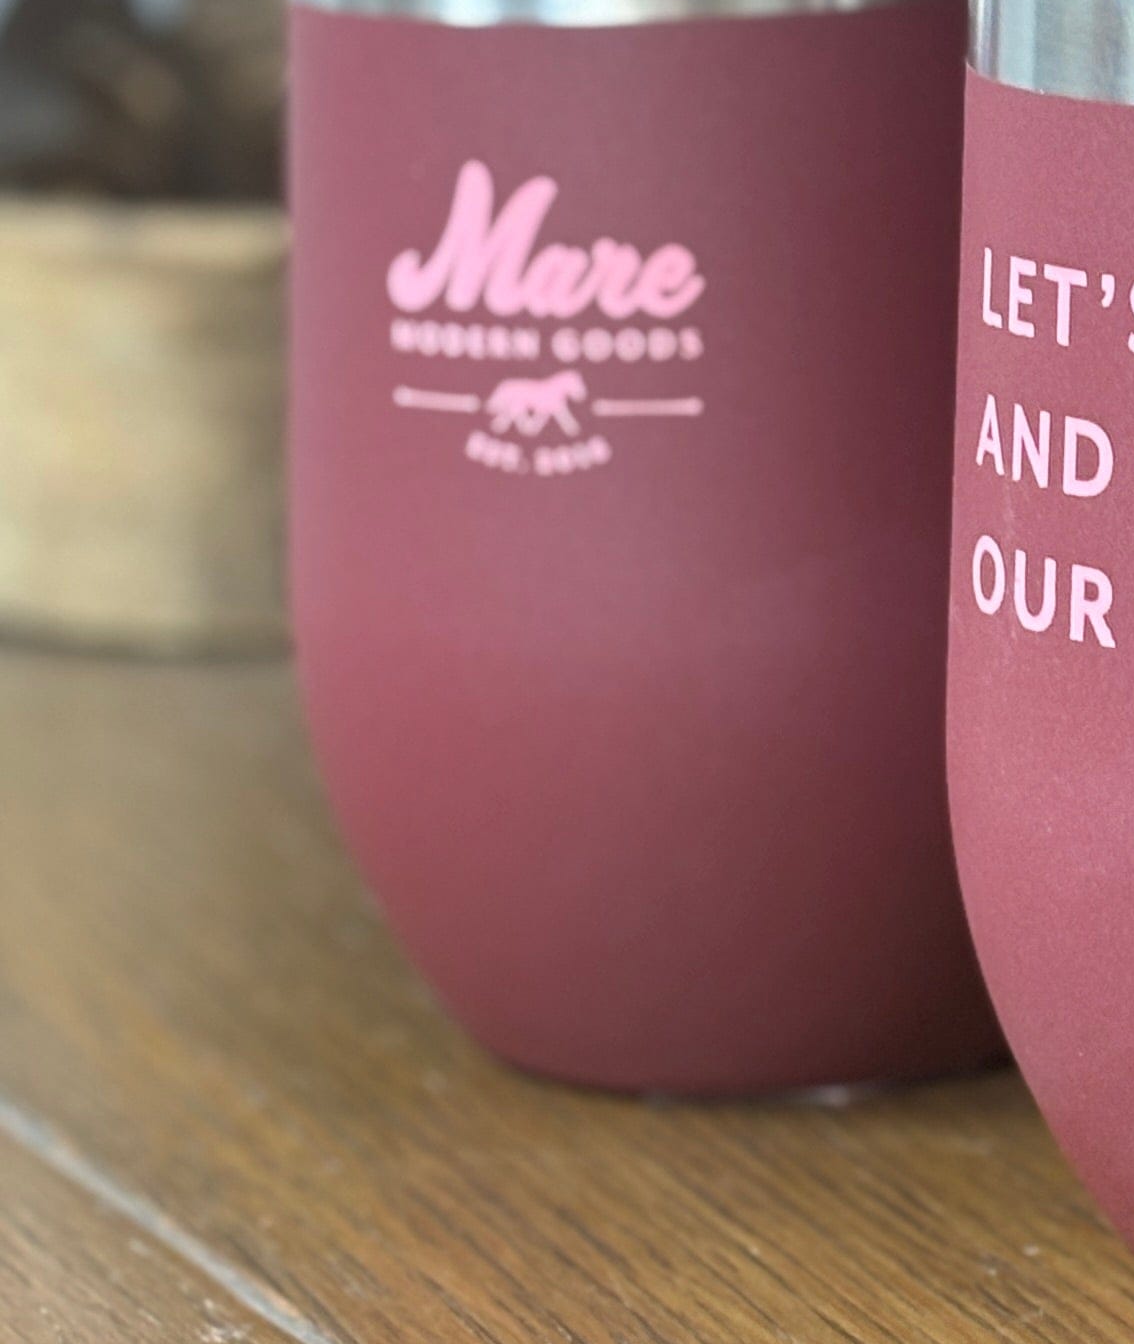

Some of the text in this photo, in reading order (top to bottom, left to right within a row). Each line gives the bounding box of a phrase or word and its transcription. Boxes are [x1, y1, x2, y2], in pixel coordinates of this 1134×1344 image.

[387, 159, 706, 320] Mare
[552, 327, 704, 363] GOODS
[975, 393, 1114, 498] AND
[971, 534, 1117, 649] OUR
